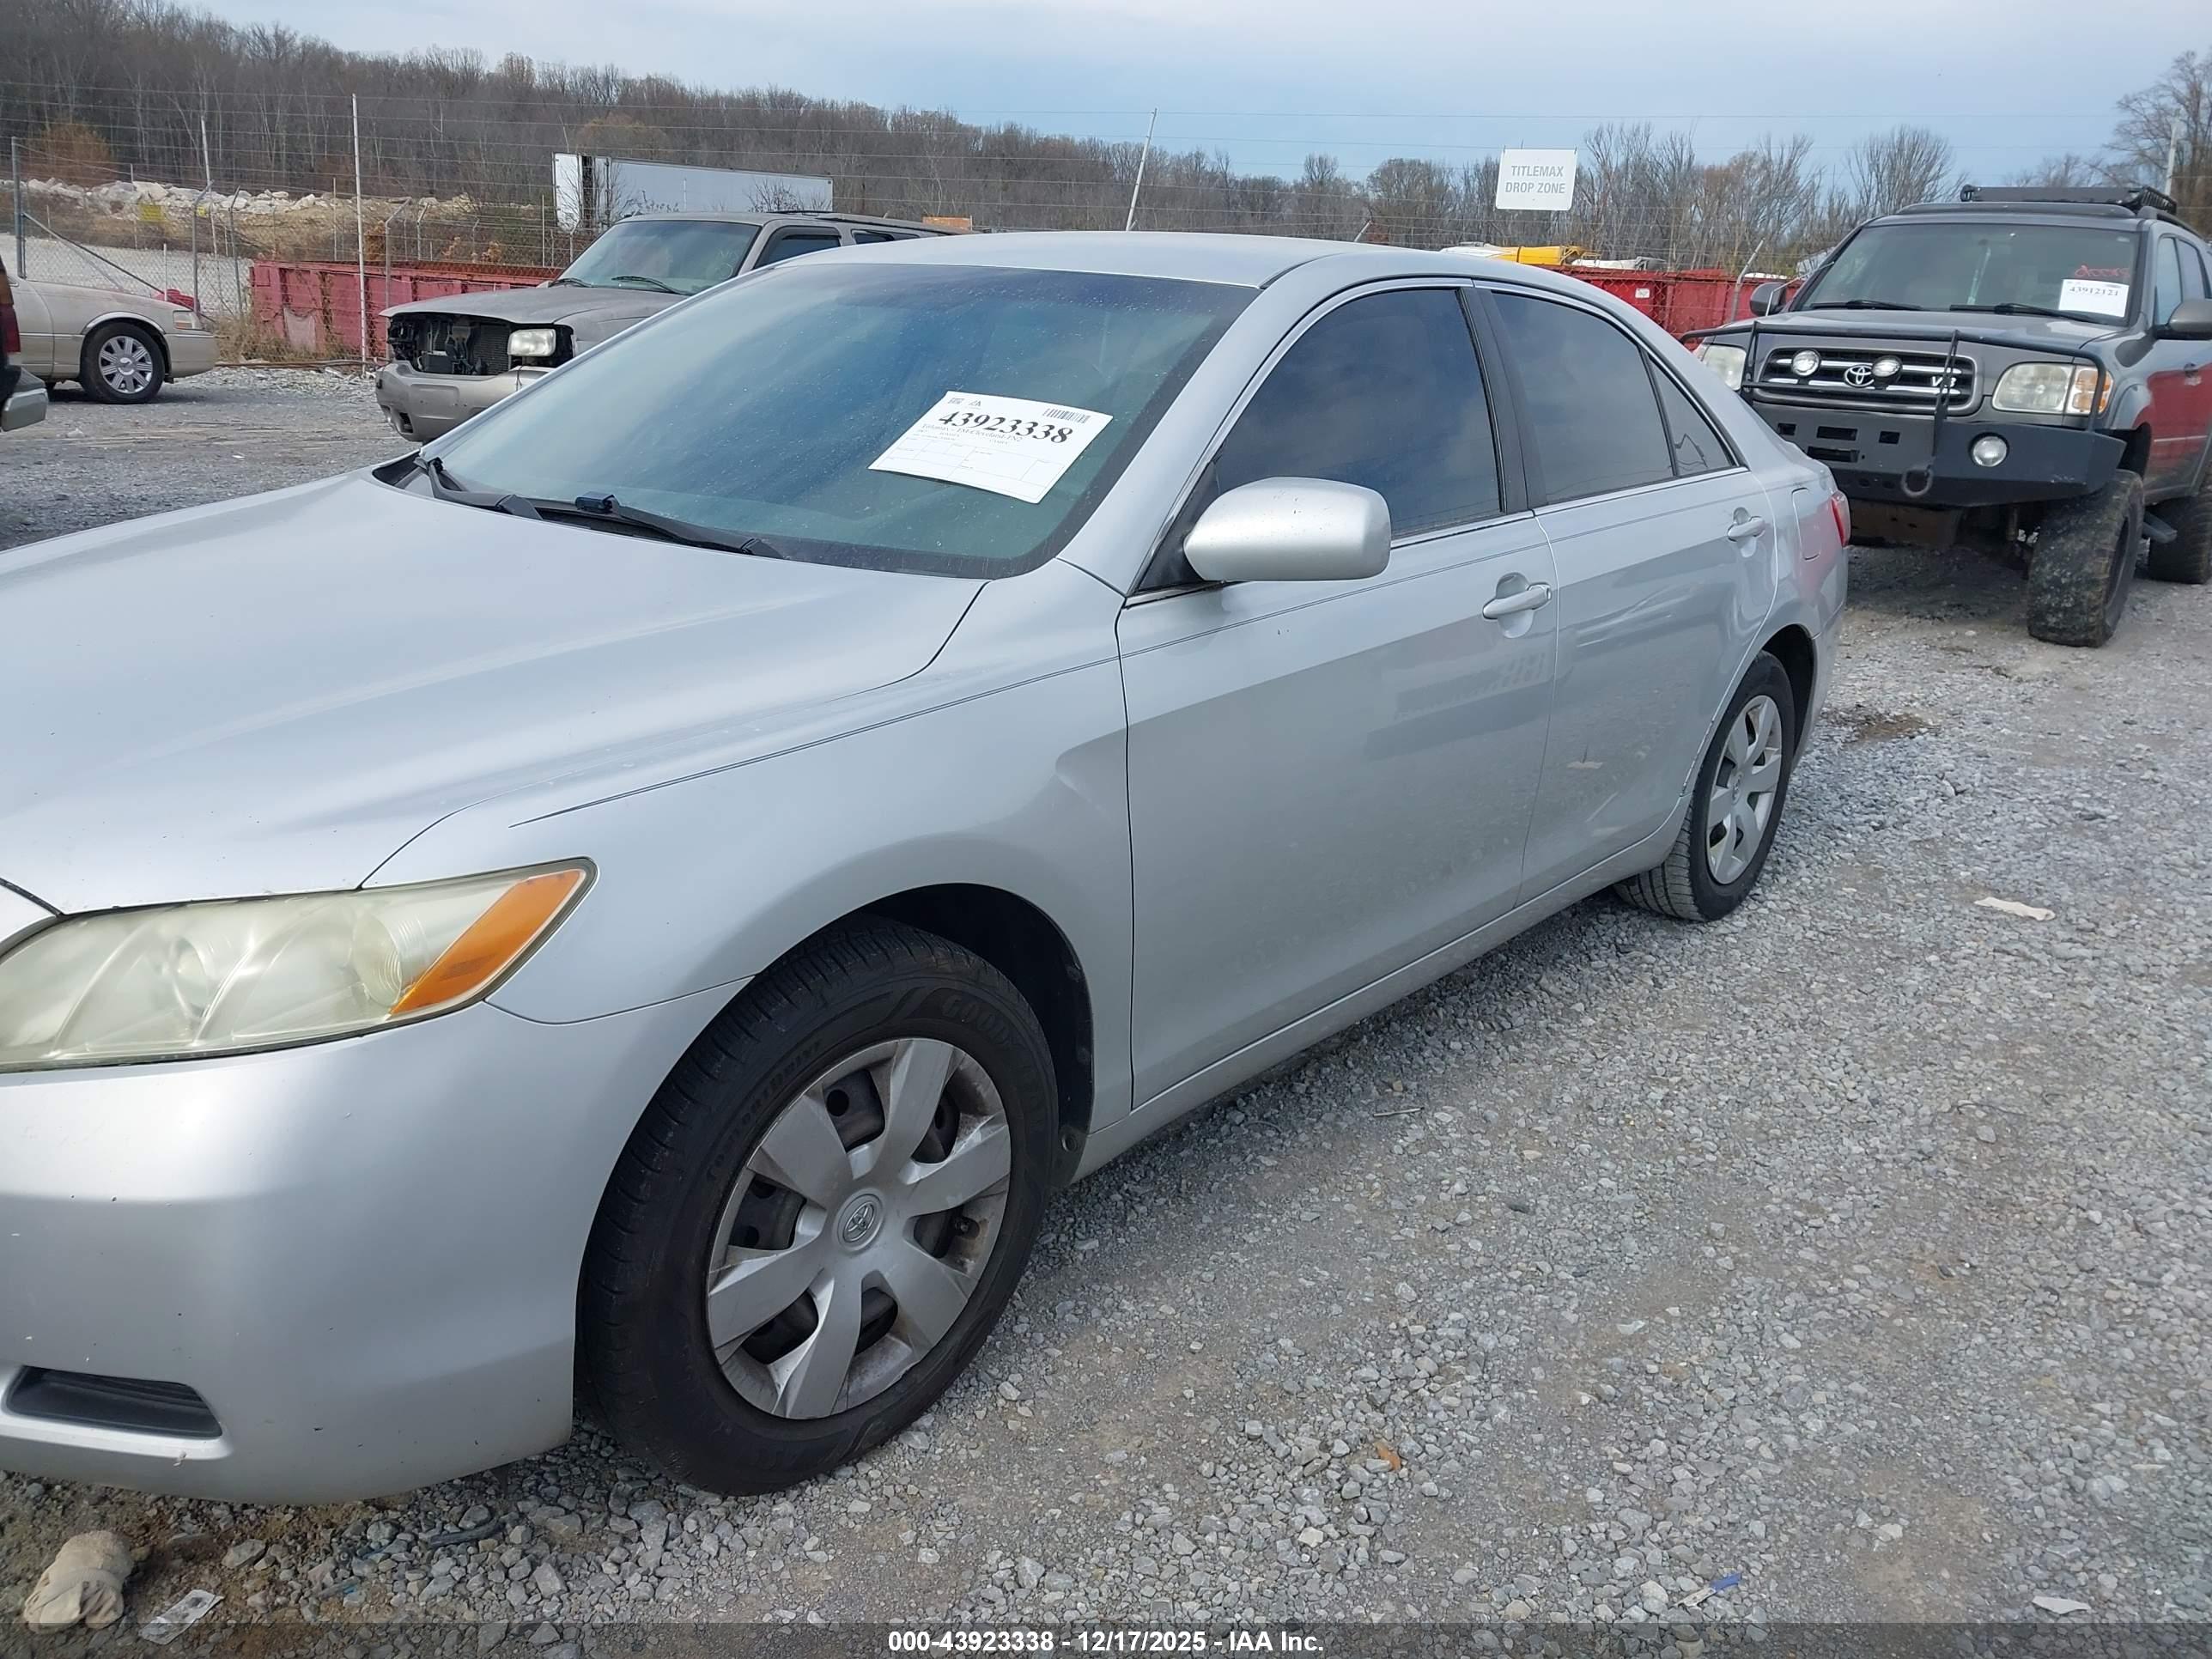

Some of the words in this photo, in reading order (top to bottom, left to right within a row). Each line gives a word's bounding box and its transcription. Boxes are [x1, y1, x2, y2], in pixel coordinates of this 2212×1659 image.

[1511, 166, 1564, 177] TITLEMAX
[1505, 182, 1534, 192] DROP
[1537, 182, 1566, 194] ZONE
[2069, 286, 2119, 297] 43912121
[939, 410, 1074, 443] 43923338
